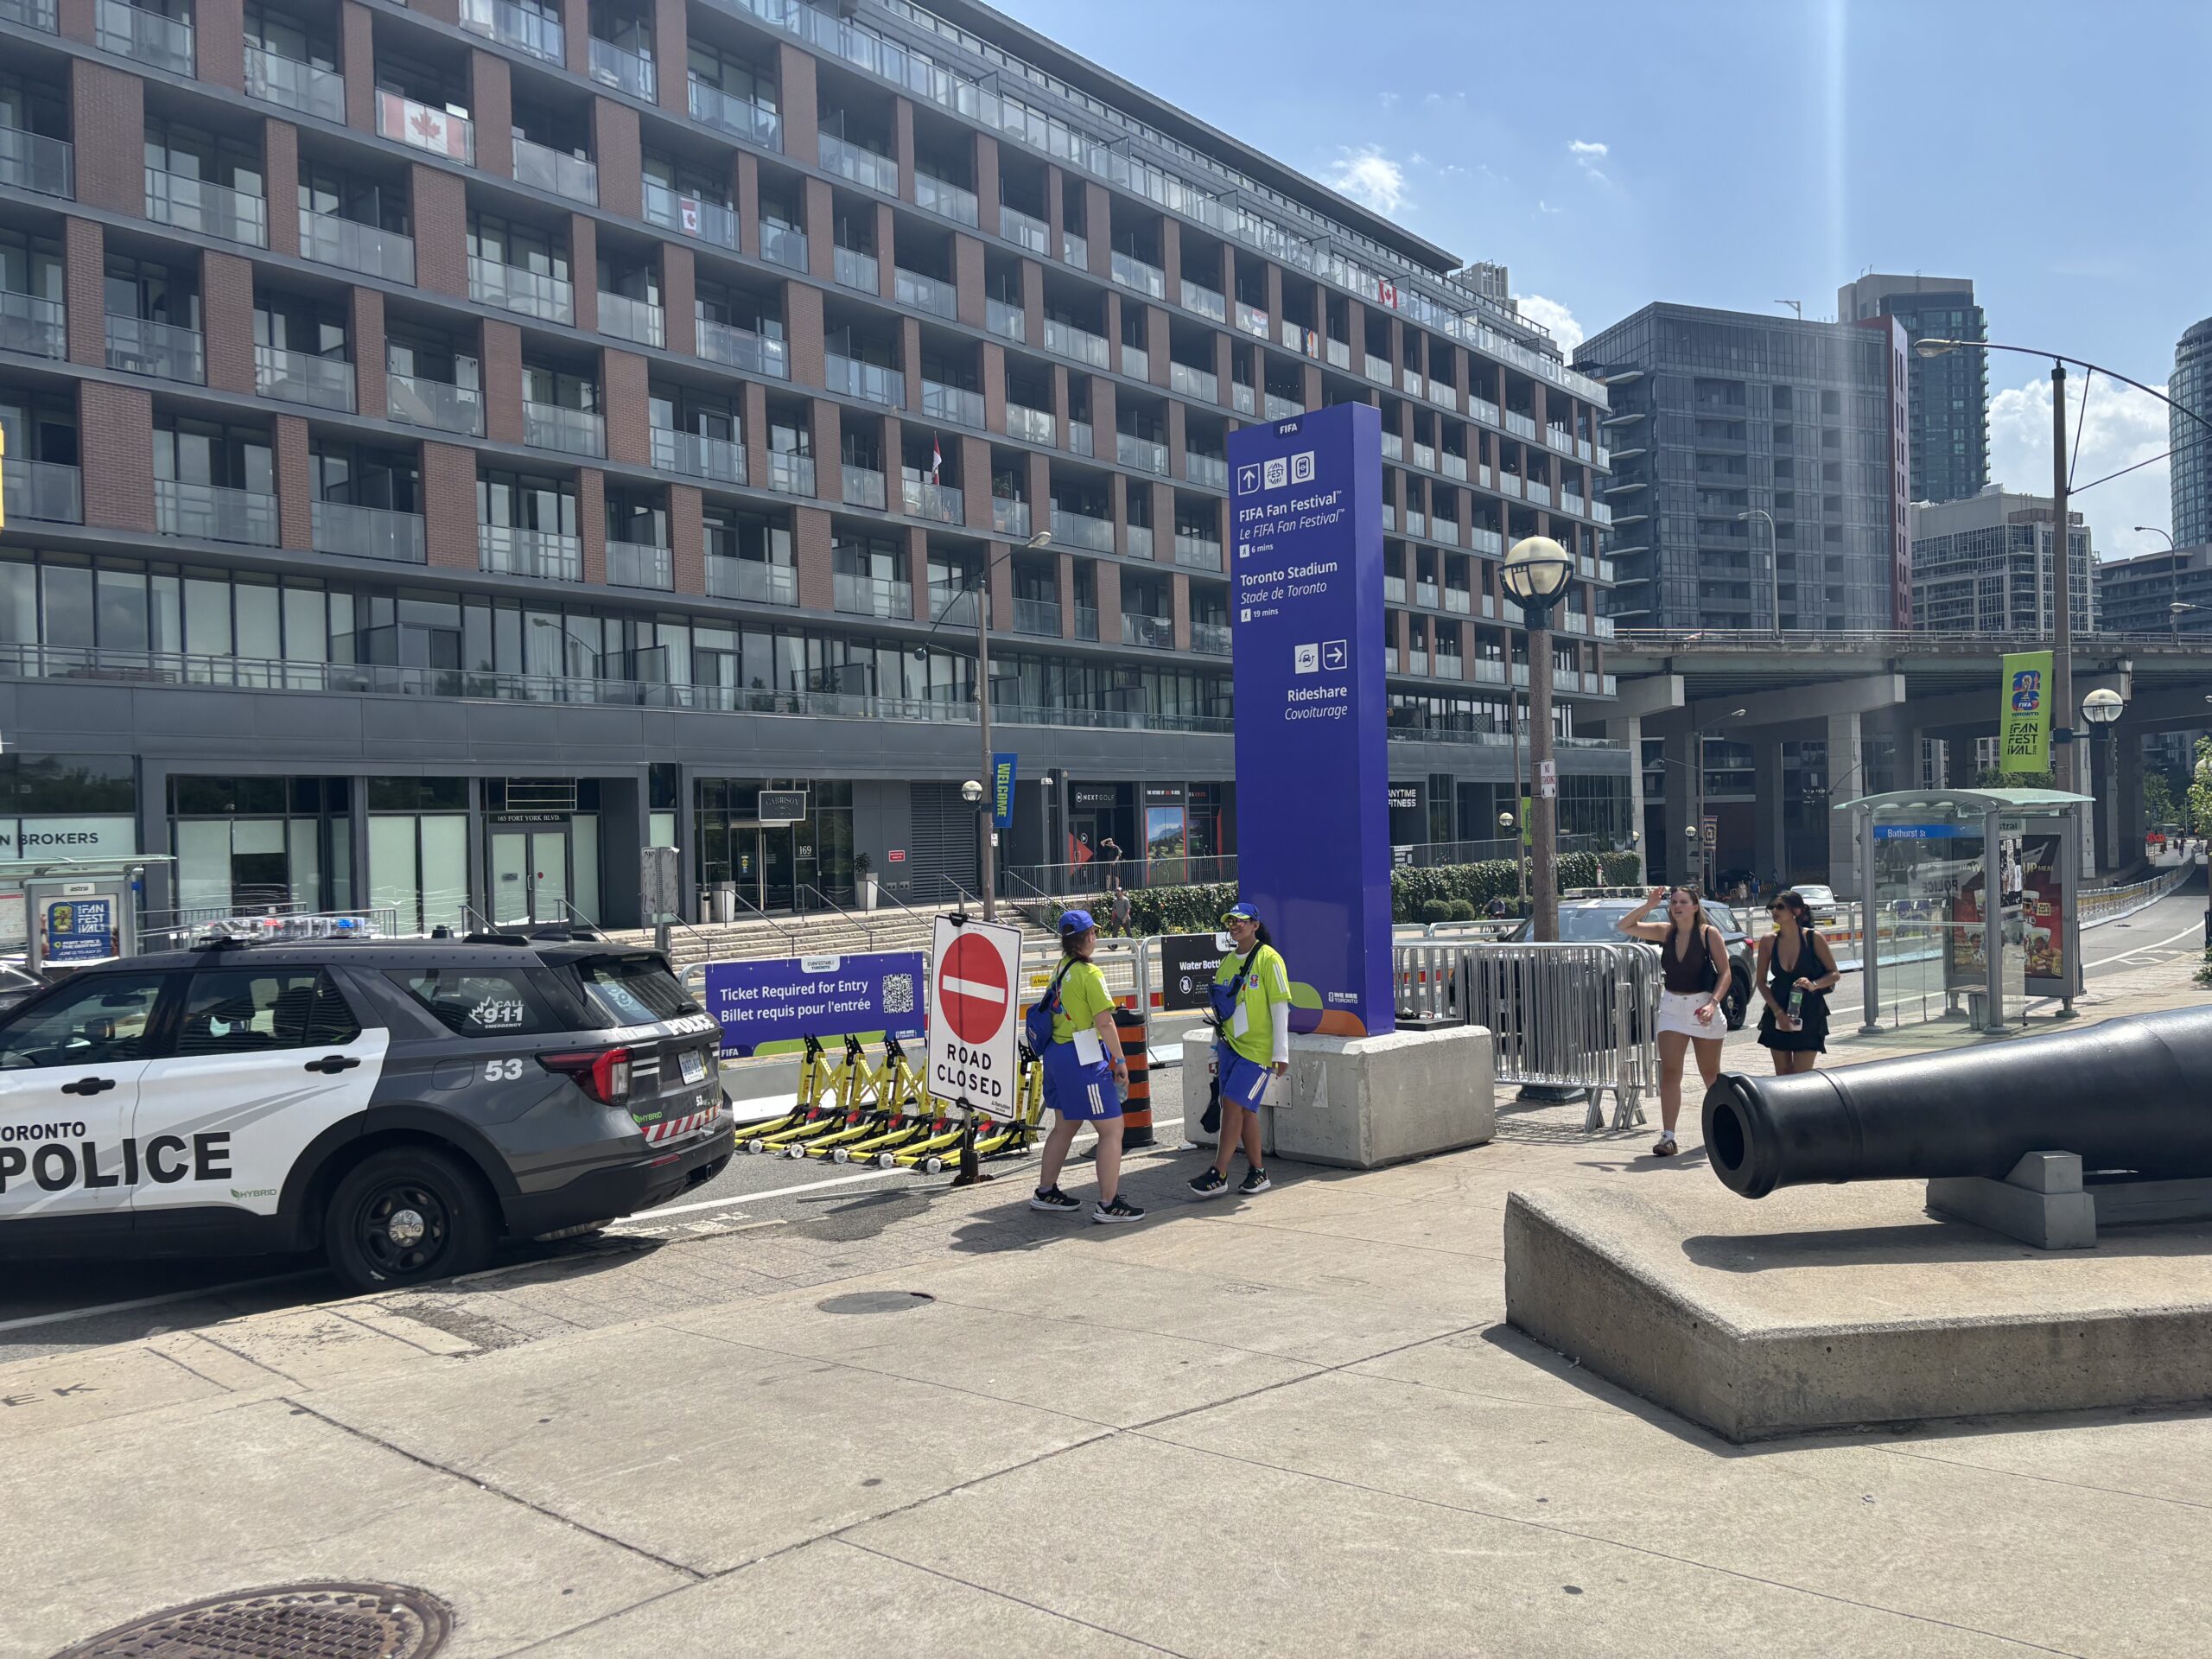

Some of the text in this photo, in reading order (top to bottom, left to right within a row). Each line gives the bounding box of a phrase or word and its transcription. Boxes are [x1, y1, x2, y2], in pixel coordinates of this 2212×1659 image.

[1280, 423, 1298, 435] FIFA
[1239, 507, 1264, 523] FIFA
[1267, 505, 1287, 518] Fan
[1239, 528, 1250, 540] Le
[1253, 523, 1274, 537] FIFA
[1277, 520, 1296, 533] Fan
[1257, 543, 1274, 552] mins
[1240, 562, 1338, 587] Toronto Stadium
[1241, 582, 1327, 605] Stade de Toronto
[1262, 608, 1279, 617] mins
[1287, 686, 1348, 702] Rideshare
[1285, 705, 1348, 721] Covoiturage
[2009, 734, 2038, 744] FEST
[997, 763, 1011, 817] WELCOME
[21, 832, 99, 846] BROKERS
[1887, 829, 1918, 838] Bathurst
[799, 845, 812, 855] 169
[2022, 862, 2037, 873] UP
[78, 913, 105, 924] FEST
[1179, 959, 1221, 971] Water Bottl
[720, 980, 868, 1001] Ticket Required for Entry
[484, 1007, 524, 1024] 9-1-1
[721, 999, 871, 1022] Billet requis pour l'entrée
[662, 1014, 715, 1036] POLICE
[721, 1047, 739, 1058] FIFA
[947, 1043, 992, 1071] ROAD
[484, 1058, 523, 1082] 53
[938, 1064, 1001, 1097] CLOSED
[696, 1095, 703, 1107] 53
[640, 1110, 663, 1122] HYBRID
[0, 1122, 86, 1141] ORONTO
[0, 1131, 232, 1194] POLICE
[239, 1188, 277, 1199] HYBRID
